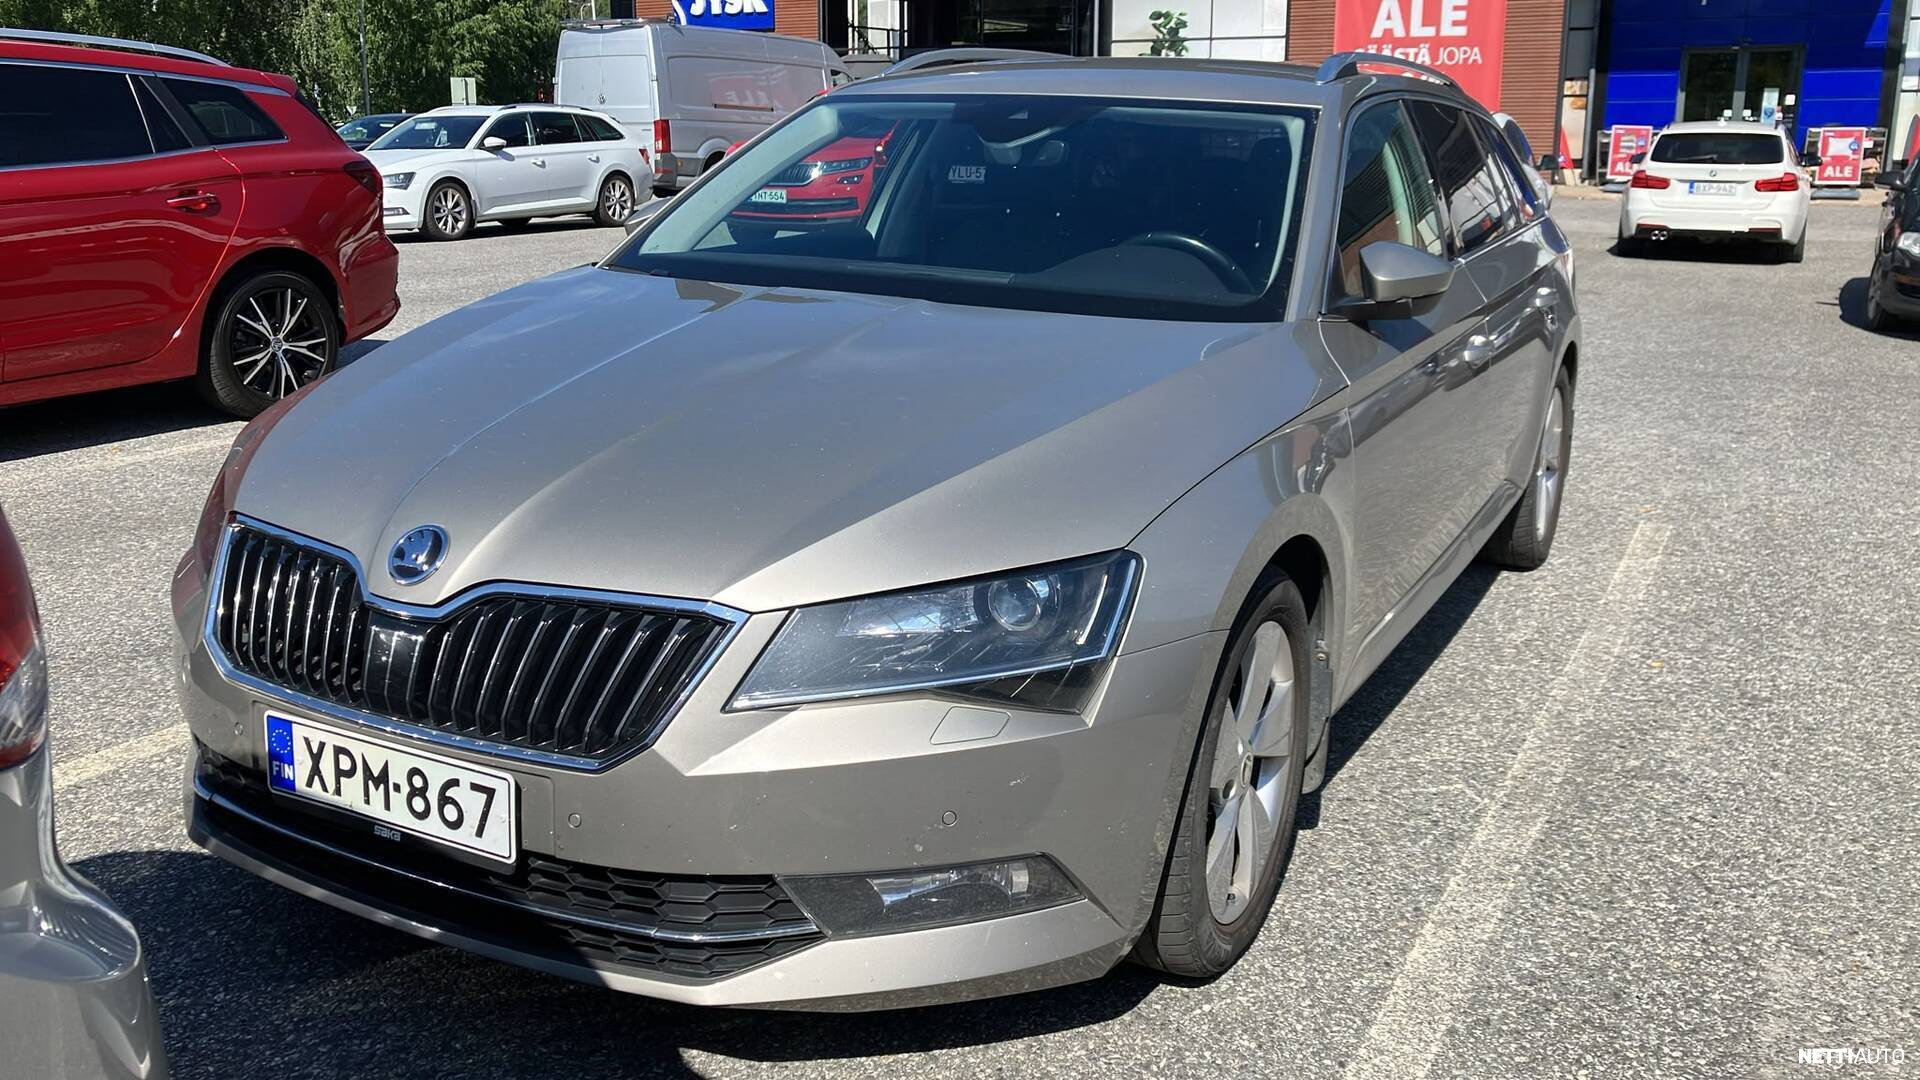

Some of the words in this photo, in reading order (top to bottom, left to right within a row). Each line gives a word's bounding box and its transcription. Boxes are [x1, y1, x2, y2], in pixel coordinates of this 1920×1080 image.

[1370, 0, 1468, 38] ALE
[1354, 43, 1432, 66] ÄSTÄ
[1434, 46, 1483, 66] JOPA
[1823, 165, 1854, 178] ALE
[272, 760, 295, 781] FIN
[302, 735, 498, 839] XPM-867
